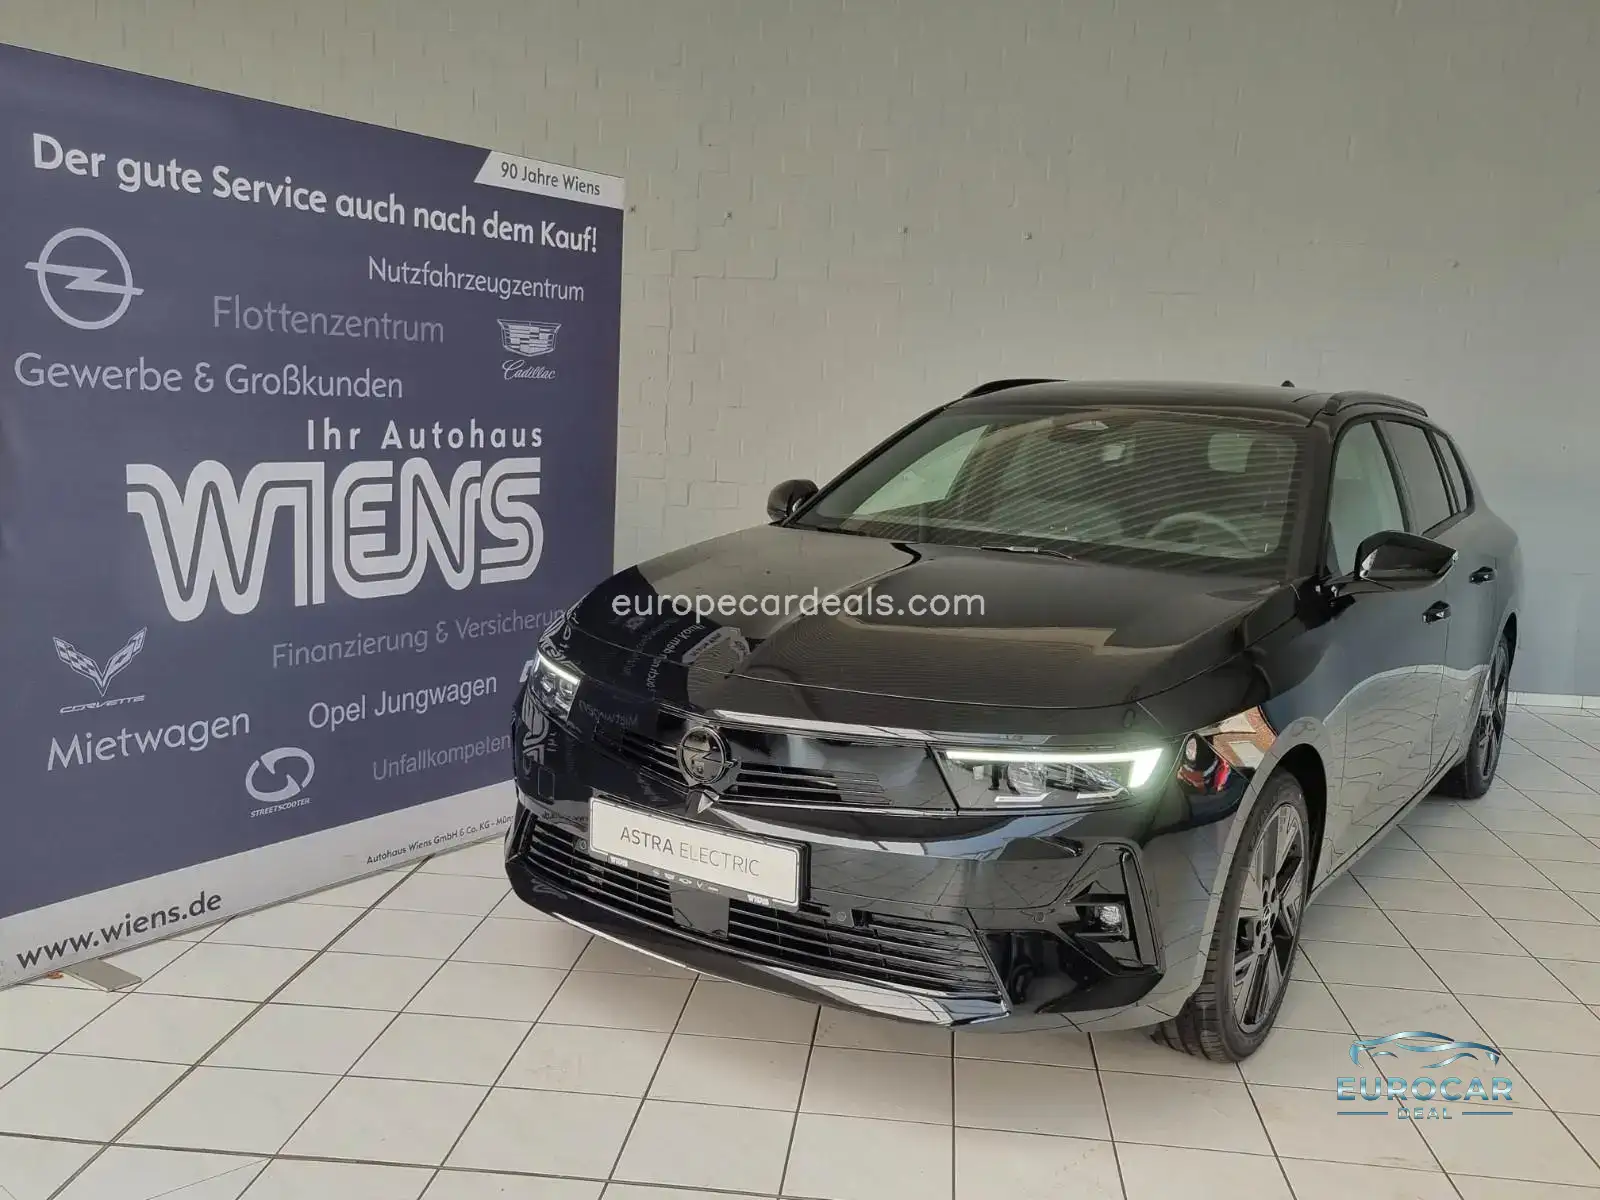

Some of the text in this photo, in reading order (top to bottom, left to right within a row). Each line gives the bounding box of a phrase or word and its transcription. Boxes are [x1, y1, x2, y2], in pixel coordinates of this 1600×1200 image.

[32, 132, 598, 253] Der gute Service auch nach dem Kauf!
[501, 161, 602, 196] 90 Jahre Wiens
[368, 255, 585, 302] Nutzfahrzeugzentrum
[212, 295, 444, 343] Flottenzentrum
[14, 352, 403, 398] Gewerbe & Großkunden
[502, 359, 557, 380] Cadillac
[307, 416, 543, 451] Ihr Autohaus
[126, 456, 544, 622] WIENS
[272, 609, 566, 669] Finanzierung & Versicherun
[60, 694, 145, 714] CORVETTE
[308, 675, 497, 733] Opel Jungwagen
[47, 711, 251, 772] Mietwagen
[372, 733, 511, 782] Unfallkompeten
[250, 797, 311, 818] STREETSCOOTER
[366, 847, 407, 865] Autohaus
[408, 838, 432, 852] Wiens
[433, 829, 458, 845] GmbH
[479, 819, 491, 831] KG
[496, 814, 514, 826] Mün
[619, 825, 761, 878] ASTRA ELECTRIC
[16, 890, 223, 970] www.wiens.de
